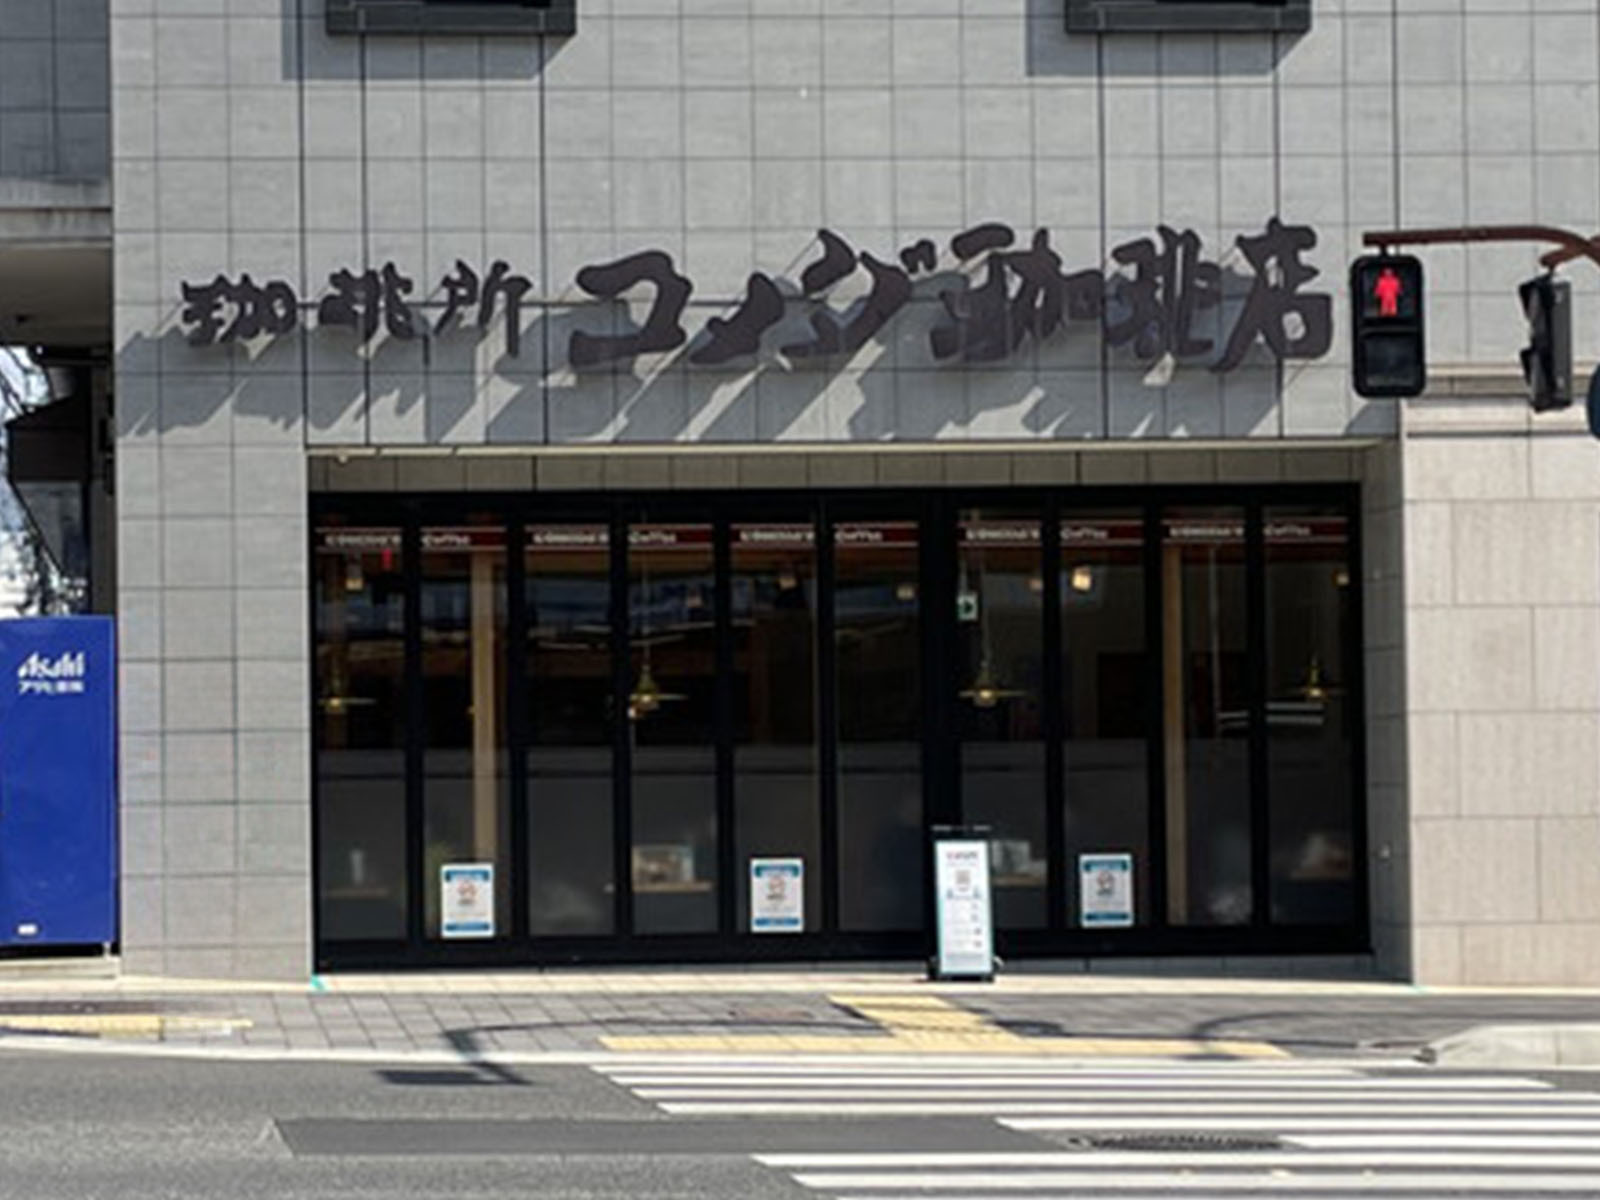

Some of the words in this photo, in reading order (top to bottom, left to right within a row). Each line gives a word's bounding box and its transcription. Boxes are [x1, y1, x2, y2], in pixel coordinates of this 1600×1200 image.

[181, 259, 533, 358] 珈琲所
[568, 216, 1334, 373] コメダ珈琲店
[18, 652, 84, 678] Asahi
